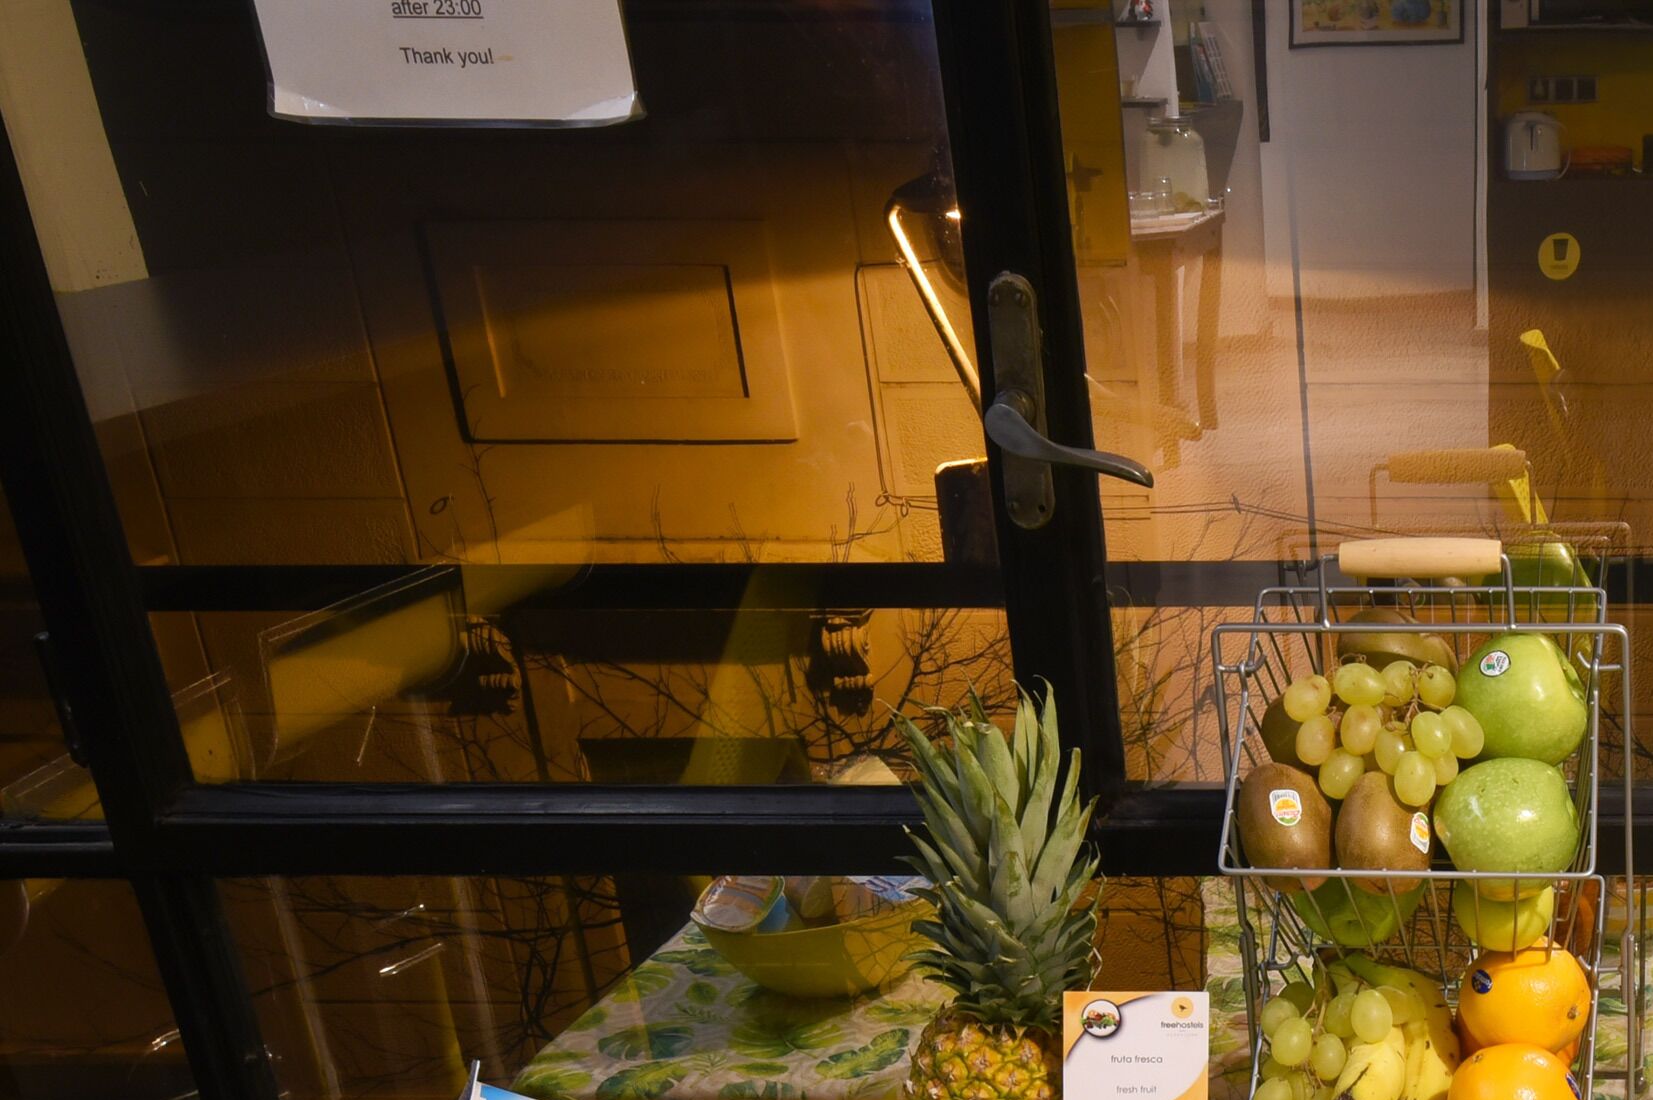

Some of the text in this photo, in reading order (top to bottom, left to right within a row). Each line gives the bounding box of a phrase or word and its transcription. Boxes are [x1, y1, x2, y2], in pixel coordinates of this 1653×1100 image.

[392, 0, 482, 15] after 23:00
[399, 47, 494, 69] Thank you!
[1160, 1020, 1204, 1029] freehostels
[1110, 1055, 1163, 1064] fruta fresca
[1116, 1085, 1157, 1094] fresh fruit
